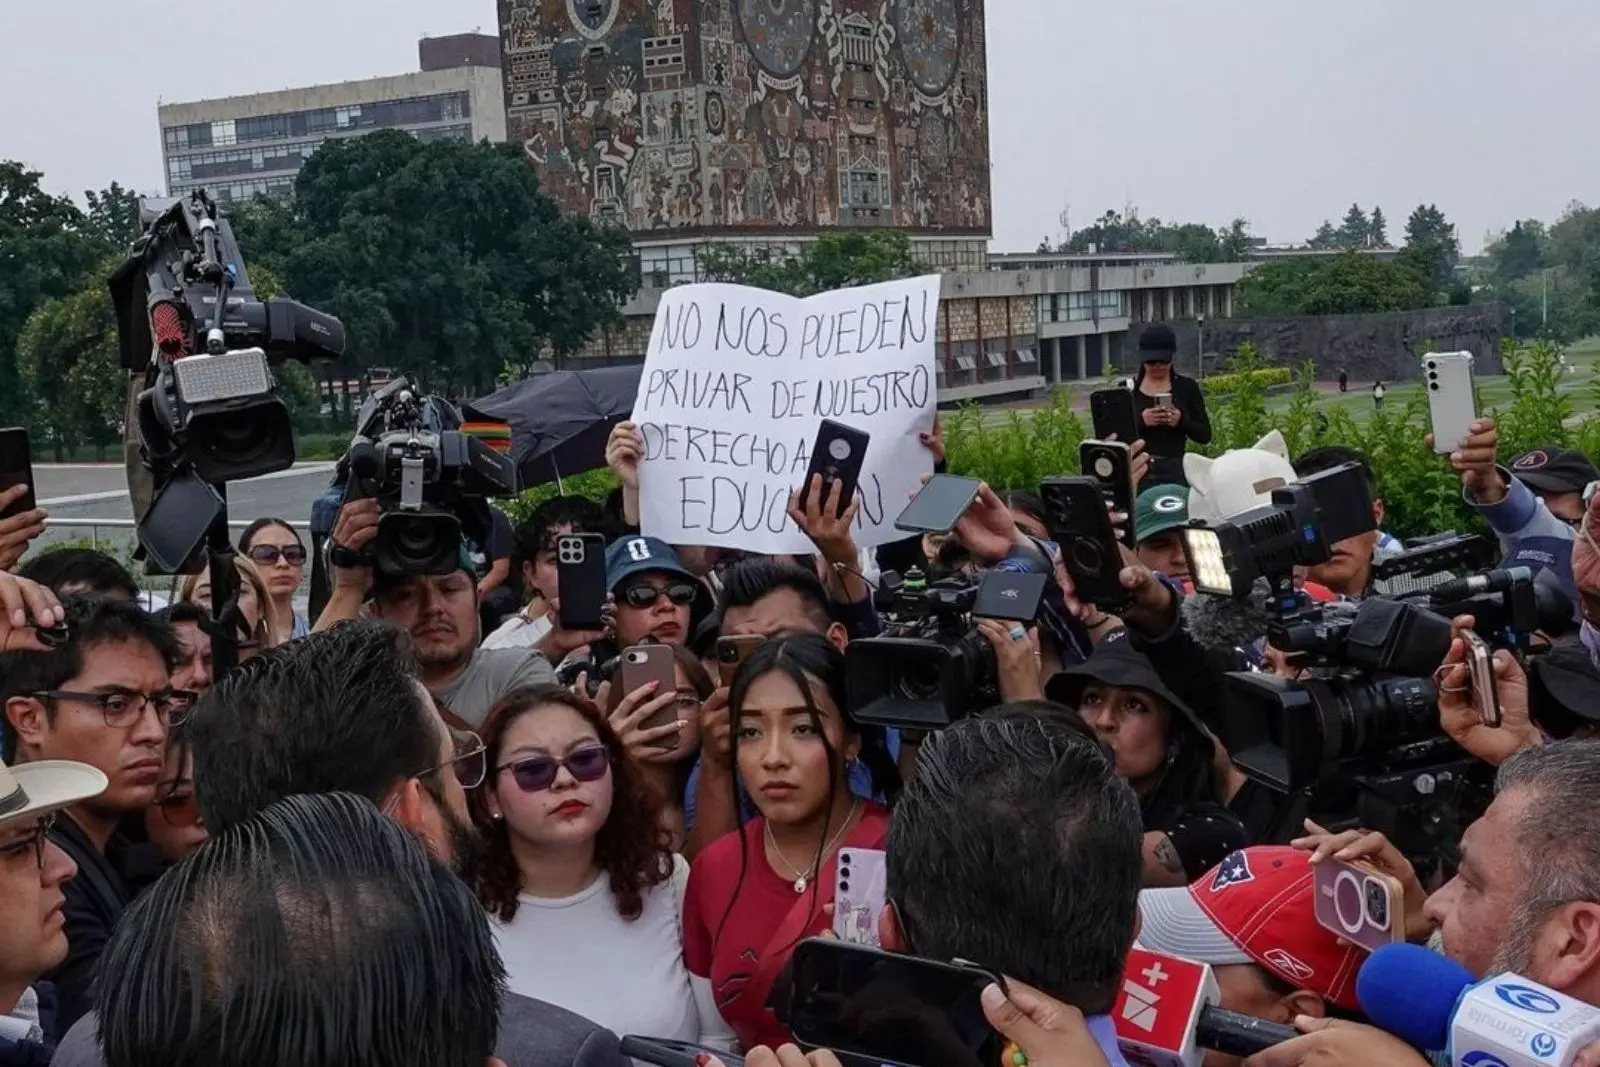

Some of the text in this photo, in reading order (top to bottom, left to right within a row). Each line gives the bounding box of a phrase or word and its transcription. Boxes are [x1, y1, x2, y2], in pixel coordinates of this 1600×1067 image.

[659, 290, 928, 360] NO NOS PUEDEN
[644, 364, 929, 419] PRIVAR DE NUESTRO
[640, 422, 786, 475] DERECHO
